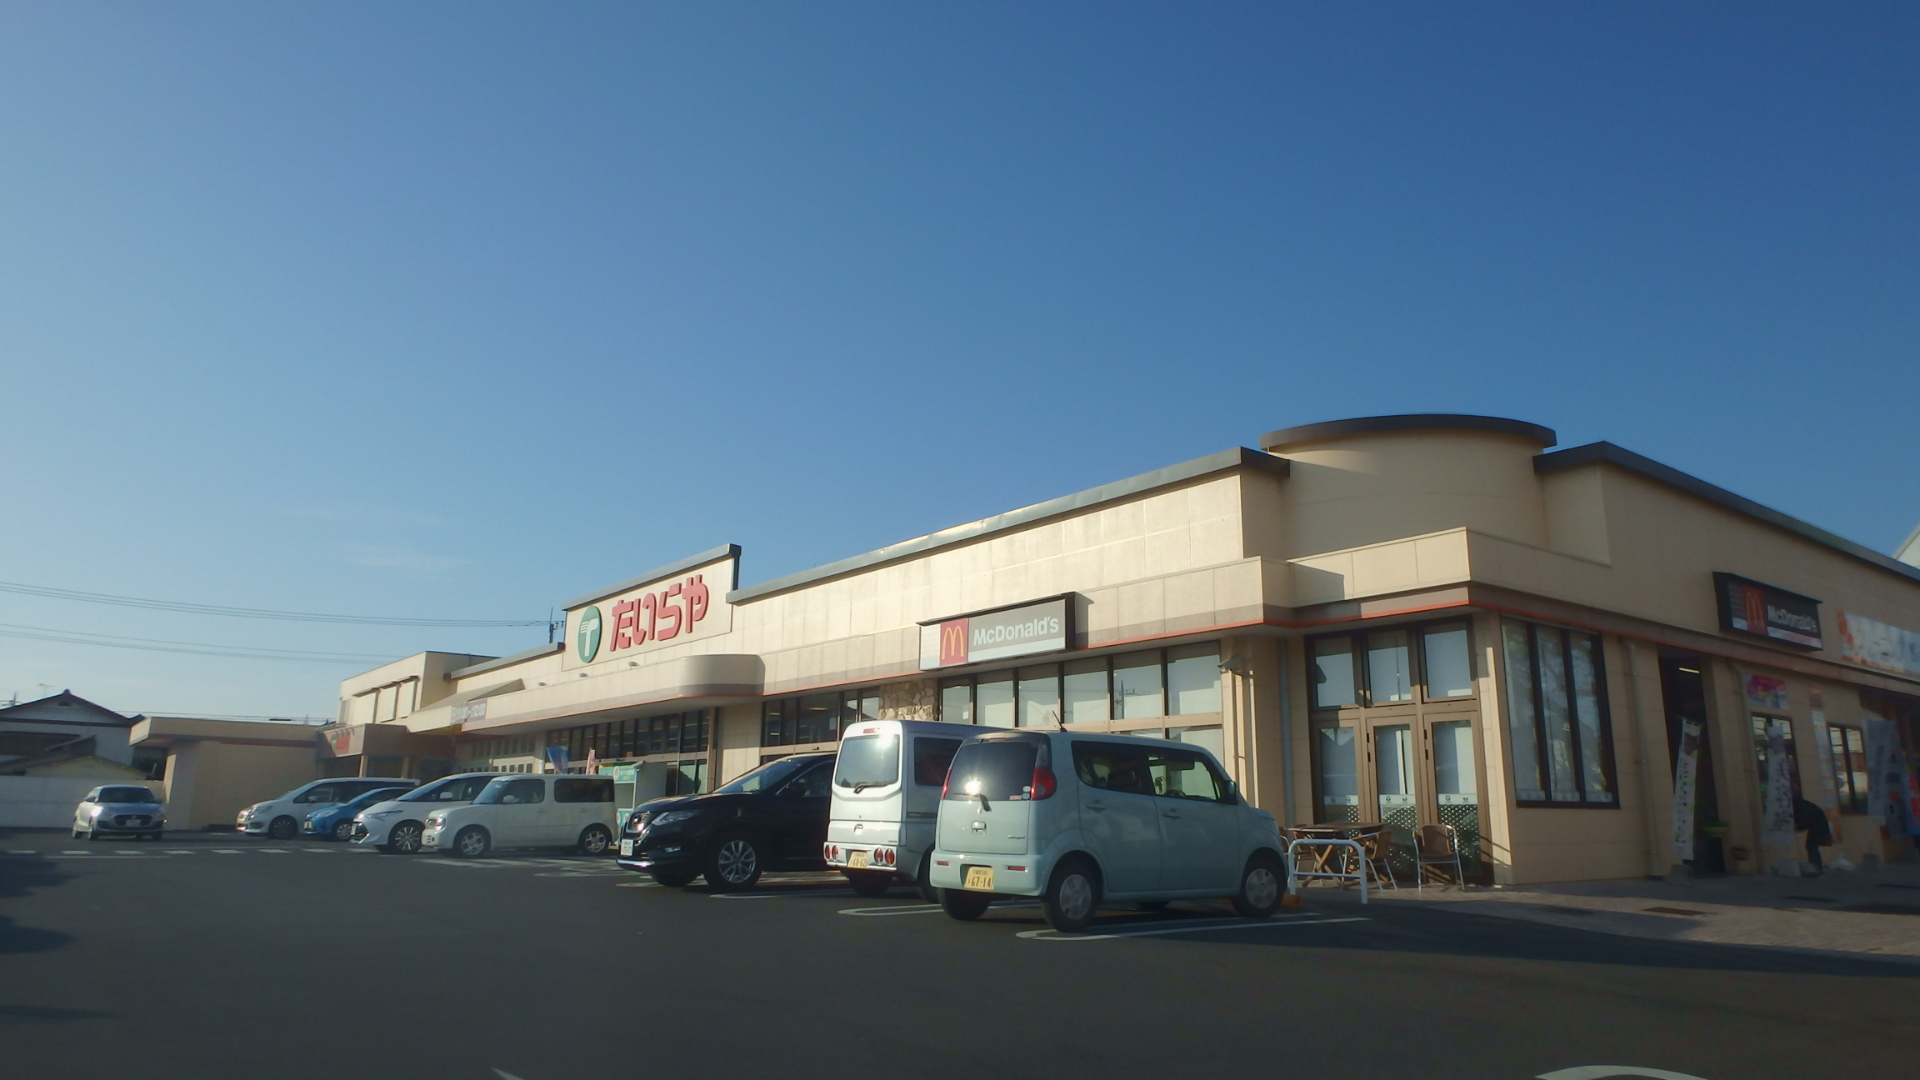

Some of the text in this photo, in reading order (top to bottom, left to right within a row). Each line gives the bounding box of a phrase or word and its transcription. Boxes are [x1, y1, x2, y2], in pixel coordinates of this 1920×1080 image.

[609, 574, 709, 652] たいらや
[973, 616, 1059, 646] McDonald's
